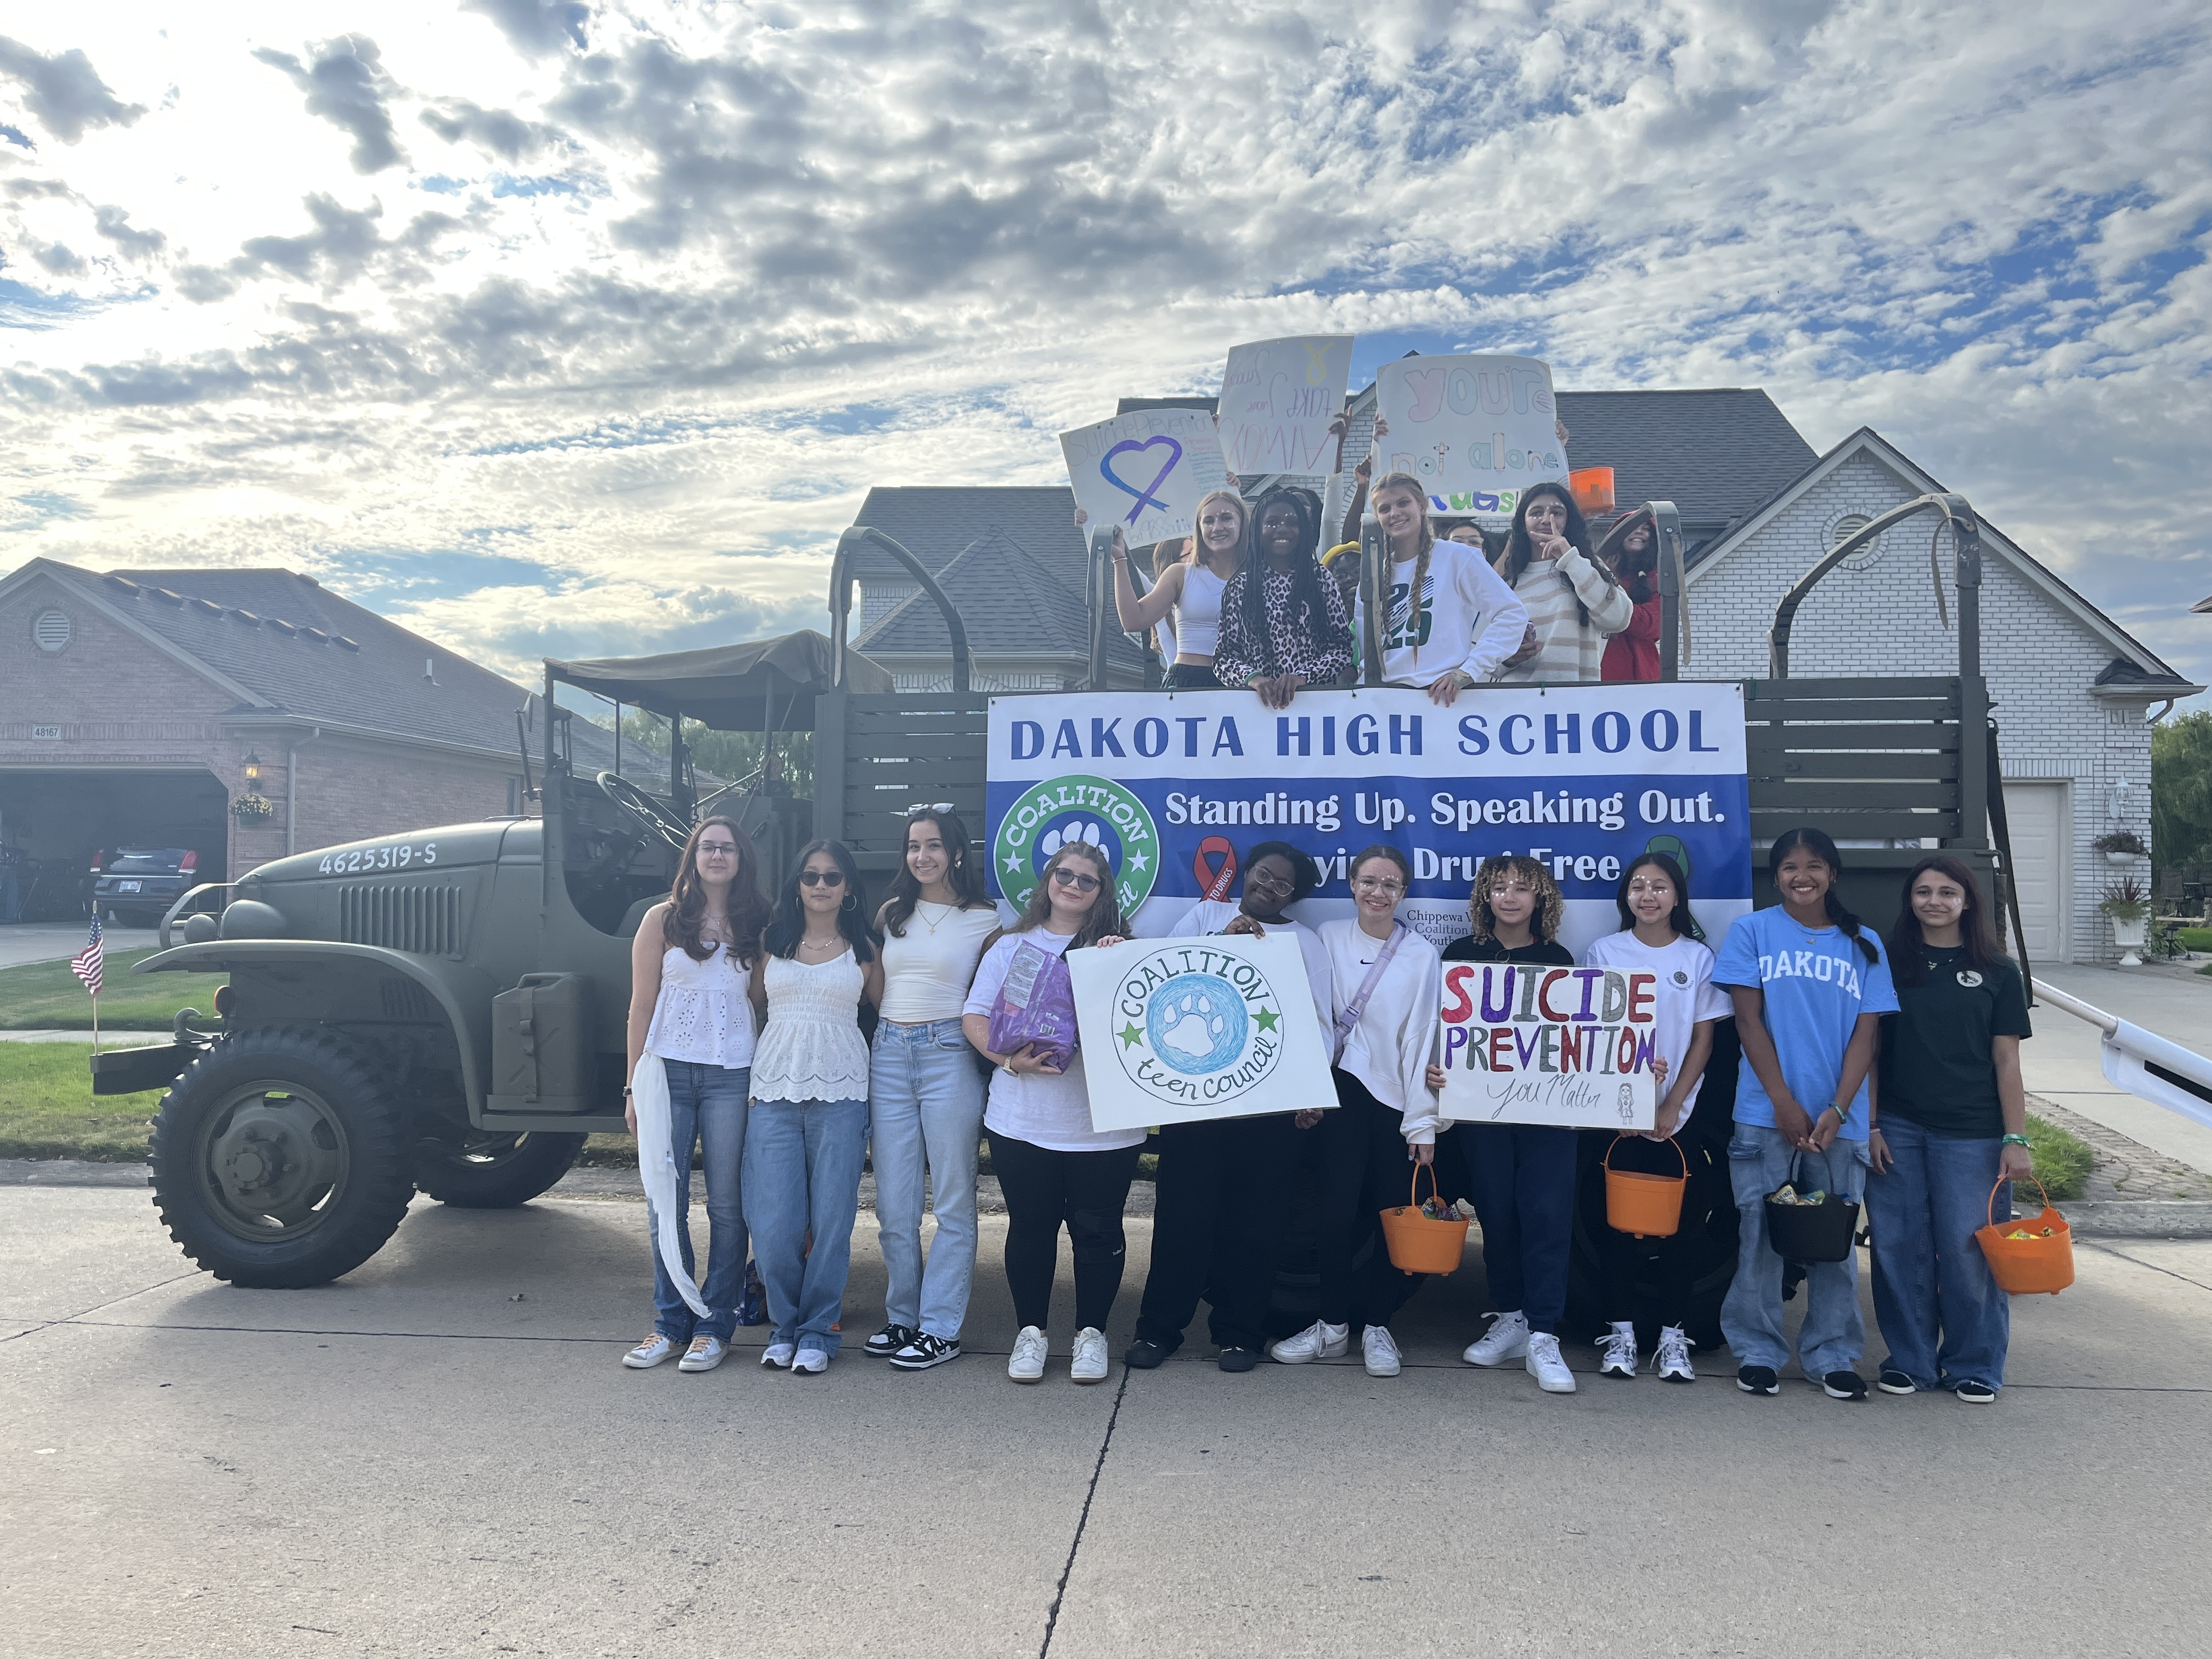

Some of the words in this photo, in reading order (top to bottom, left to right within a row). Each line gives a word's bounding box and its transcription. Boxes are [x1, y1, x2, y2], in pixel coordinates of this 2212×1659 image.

[1068, 421, 1135, 466] Suicide
[1132, 413, 1210, 438] Prevention
[1391, 442, 1449, 475] not
[1469, 432, 1559, 471] alone
[1124, 527, 1143, 544] Text
[35, 727, 58, 737] 48167
[1011, 715, 1244, 760] DAKOTA
[1277, 713, 1423, 757] HIGH
[1458, 709, 1719, 755] SCHOOL
[1006, 785, 1149, 847] COALITION
[1165, 792, 1339, 832] Standing
[1355, 792, 1416, 831] Up.
[1431, 790, 1625, 832] Speaking
[1639, 789, 1725, 823] Out.
[319, 843, 437, 874] 4625319-S
[1215, 867, 1233, 891] DRUGS
[1414, 848, 1511, 881] Dru
[1210, 889, 1221, 900] TO
[1407, 910, 1463, 924] Chippewa
[1415, 922, 1468, 935] Coalition
[1121, 950, 1270, 1018] COALITION
[1441, 966, 1656, 1023] SUICIDE
[1759, 950, 1861, 1001] DAKOTA
[1137, 1058, 1199, 1101] teen
[1203, 1036, 1277, 1098] council
[1444, 1024, 1656, 1075] PREVENTION
[1546, 1073, 1601, 1108] Matter
